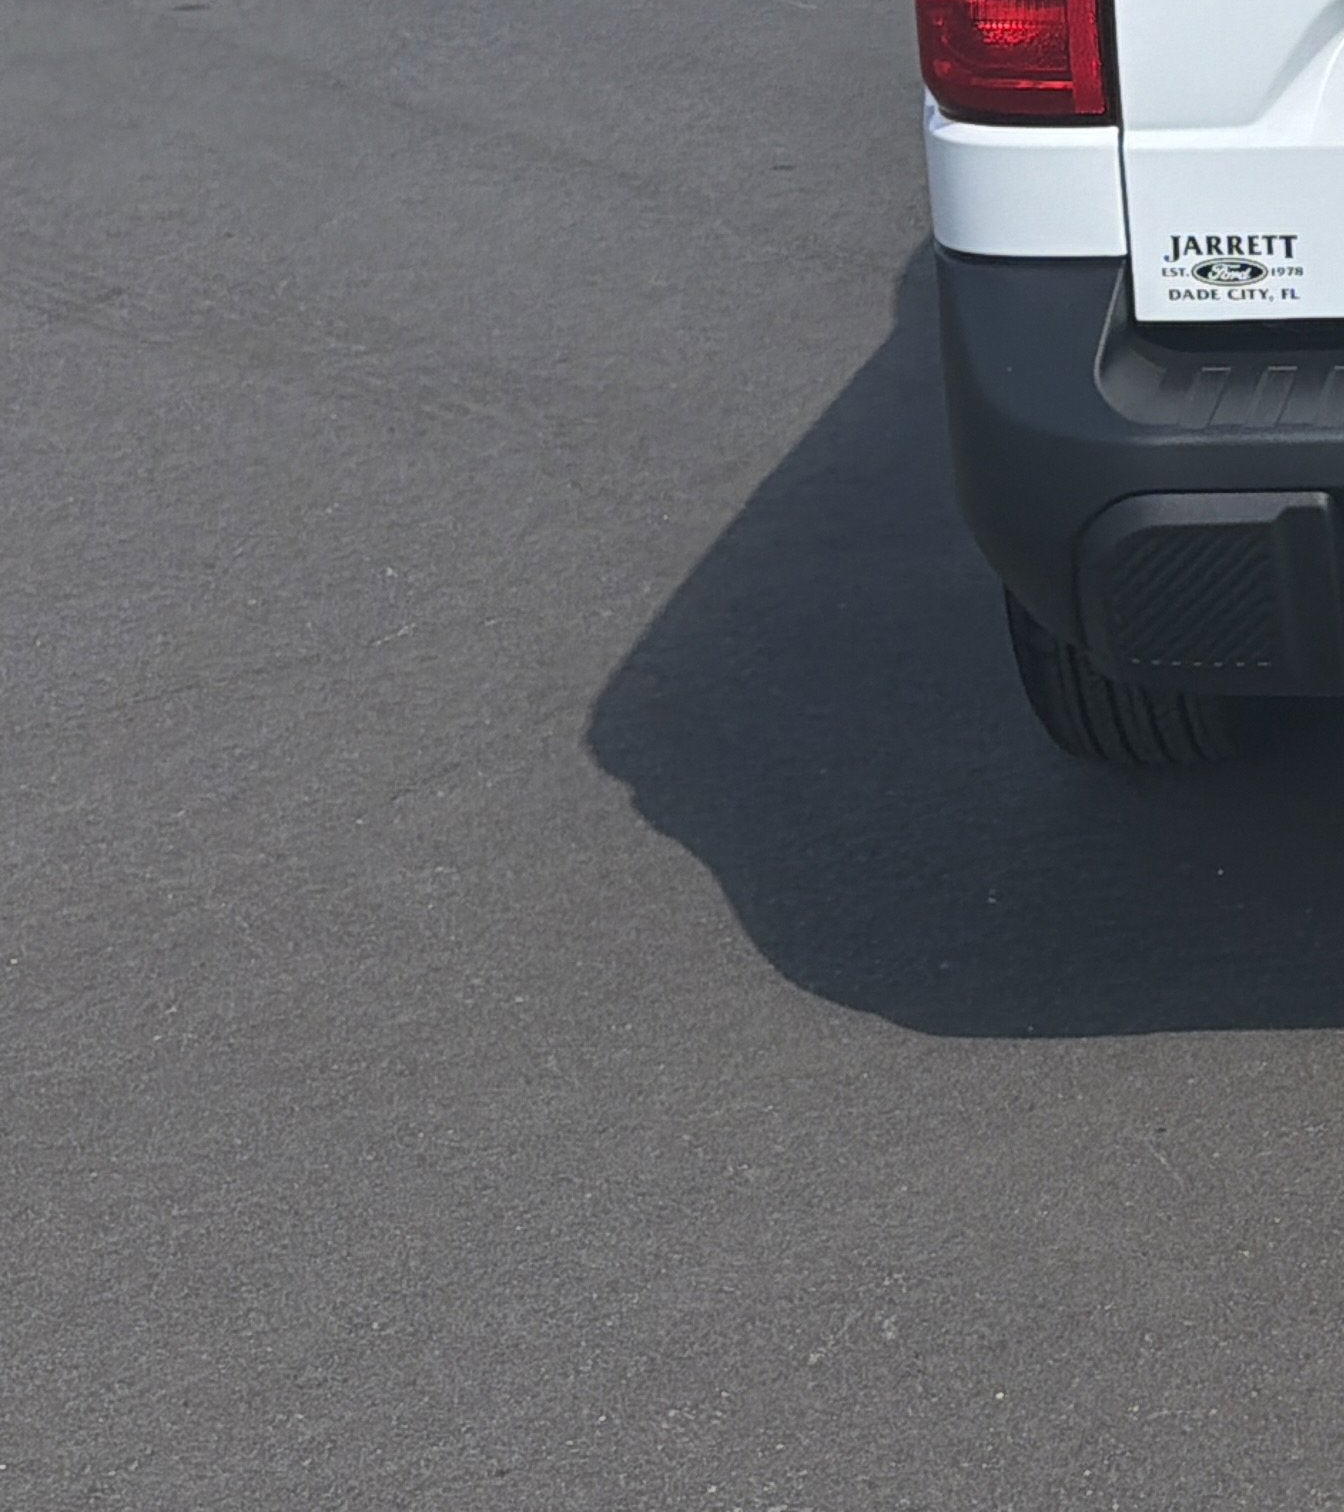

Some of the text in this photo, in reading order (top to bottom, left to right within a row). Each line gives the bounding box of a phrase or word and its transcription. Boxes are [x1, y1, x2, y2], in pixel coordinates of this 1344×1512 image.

[1163, 234, 1298, 263] JARRETT
[1161, 263, 1304, 281] EST. Ford 1978
[1168, 287, 1301, 303] DADE CITY, FL
